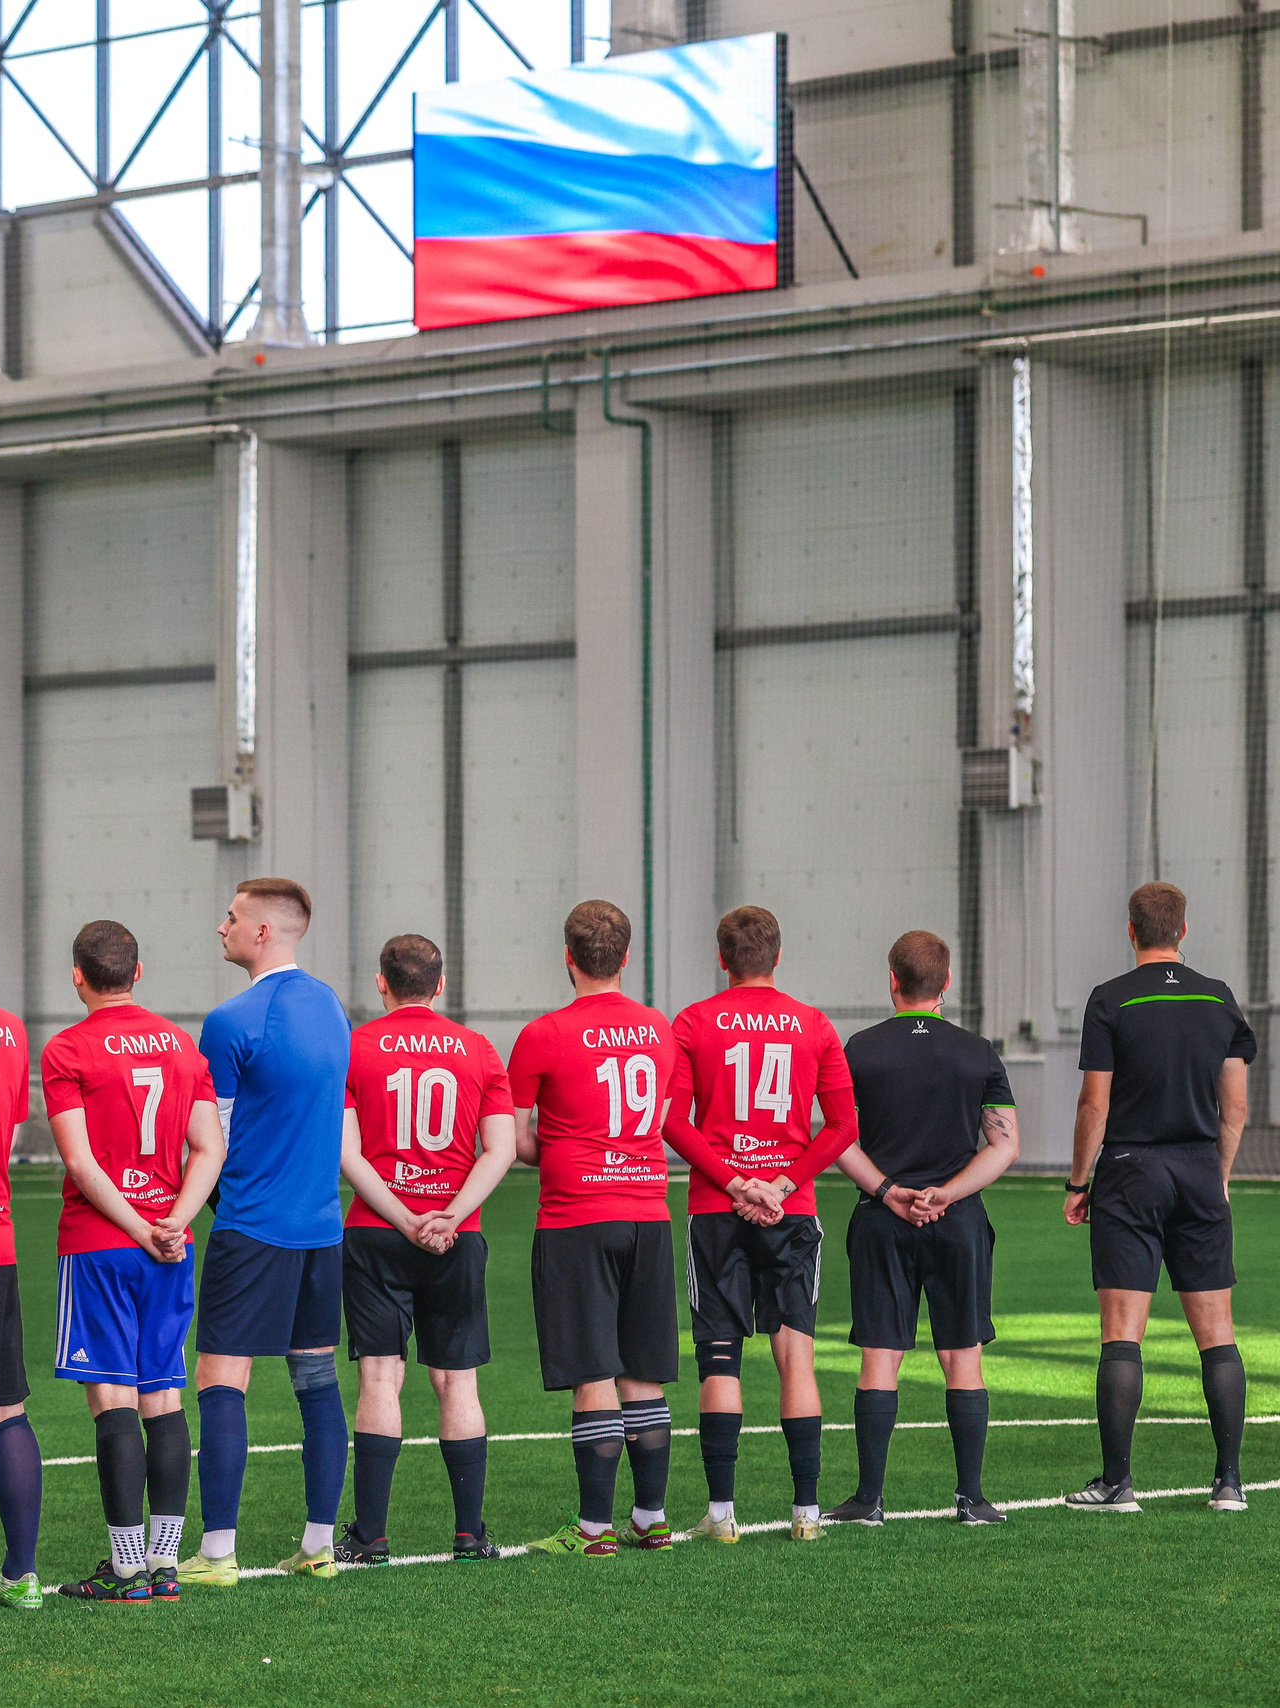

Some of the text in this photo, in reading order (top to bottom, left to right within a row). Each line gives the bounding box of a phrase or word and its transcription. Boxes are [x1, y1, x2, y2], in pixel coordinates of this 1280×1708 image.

[716, 1012, 803, 1034] САМАРА
[104, 1032, 182, 1055] САМАРА
[379, 1035, 467, 1056] САМАРА
[582, 1025, 660, 1048] САМАРА
[724, 1041, 793, 1123] 14
[596, 1053, 657, 1138] 19
[131, 1066, 165, 1155] 7
[386, 1067, 458, 1152] 10
[733, 1134, 778, 1152] DISORT
[602, 1165, 651, 1173] www.disort.ru
